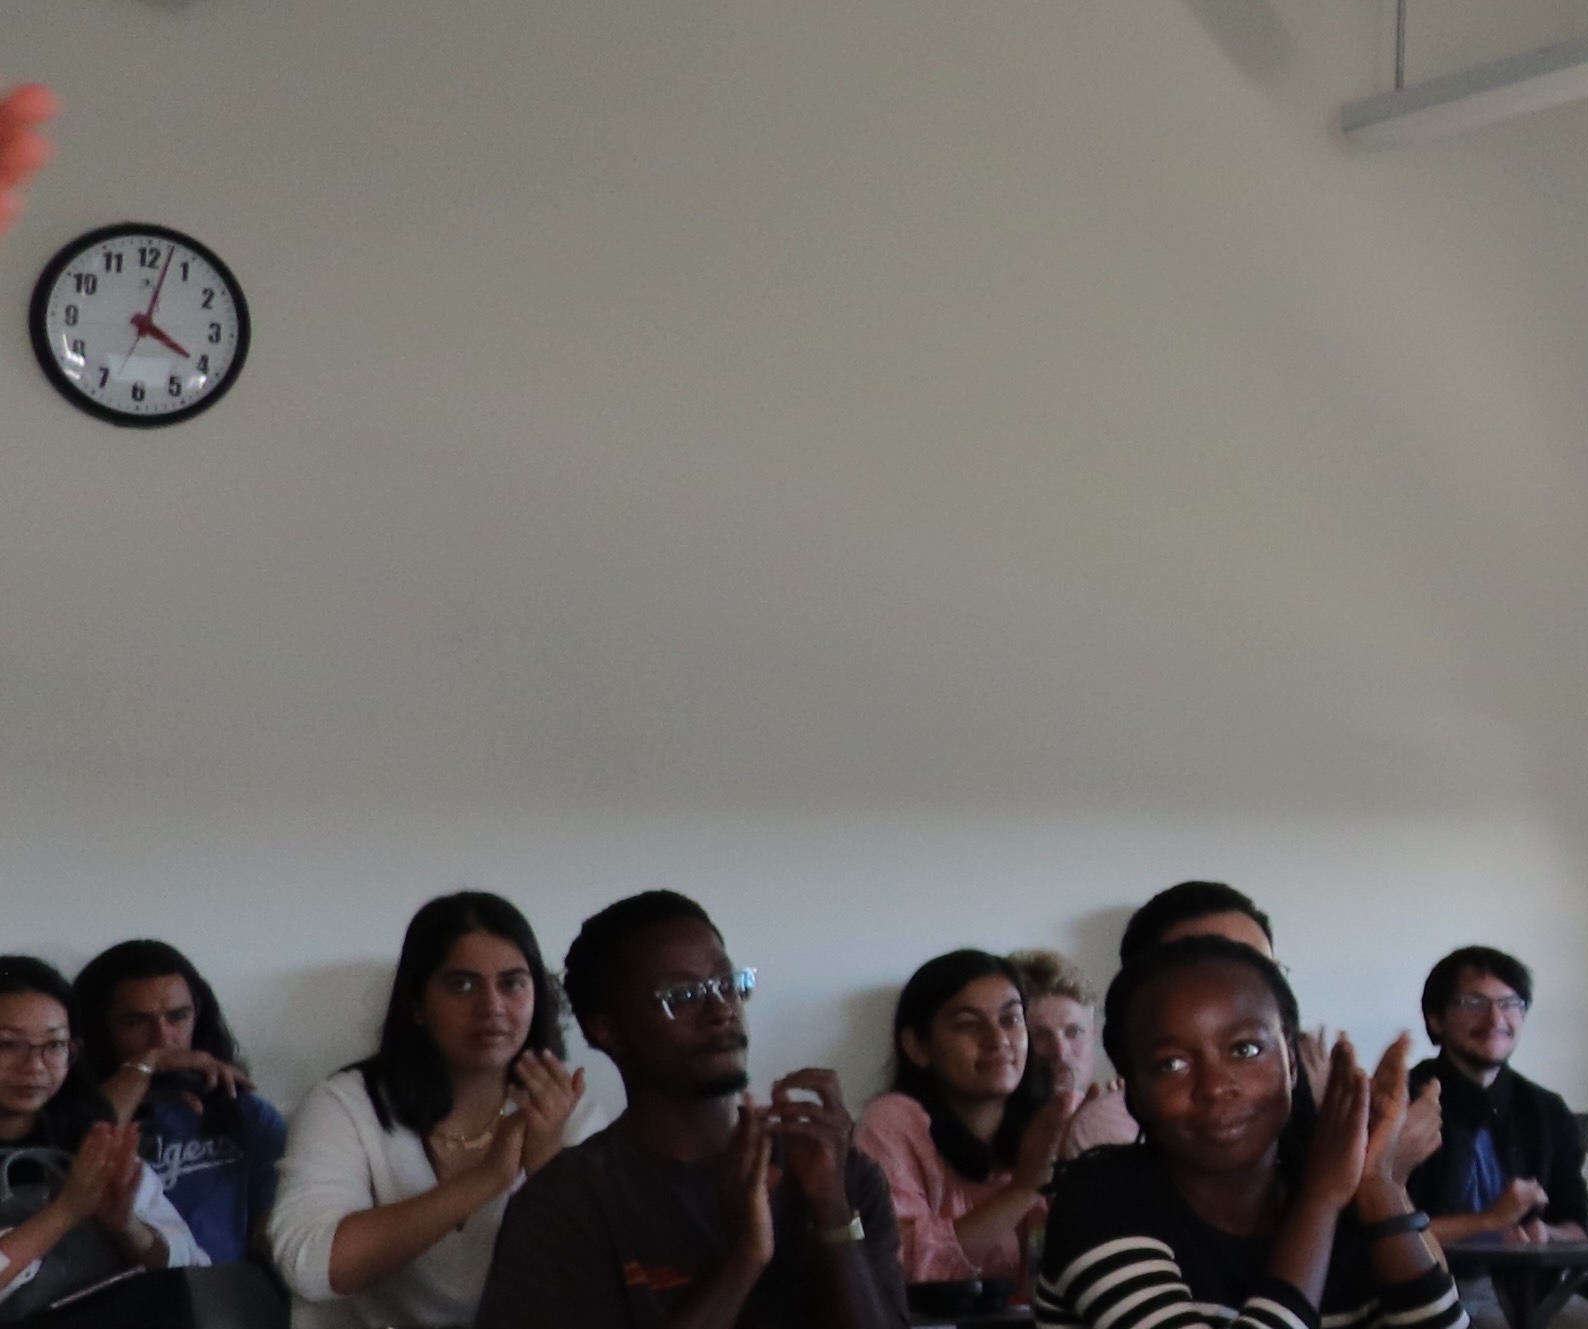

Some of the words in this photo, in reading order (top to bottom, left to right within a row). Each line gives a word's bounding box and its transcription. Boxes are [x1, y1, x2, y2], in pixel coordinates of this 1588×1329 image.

[104, 251, 123, 273] 11
[138, 247, 161, 269] 12
[180, 262, 189, 282] 1
[74, 273, 97, 295] 10
[202, 288, 215, 310] 2
[65, 305, 78, 327] 9
[209, 323, 221, 344] 3
[100, 367, 110, 388] 7
[169, 376, 182, 397] 5
[132, 383, 145, 402] 6
